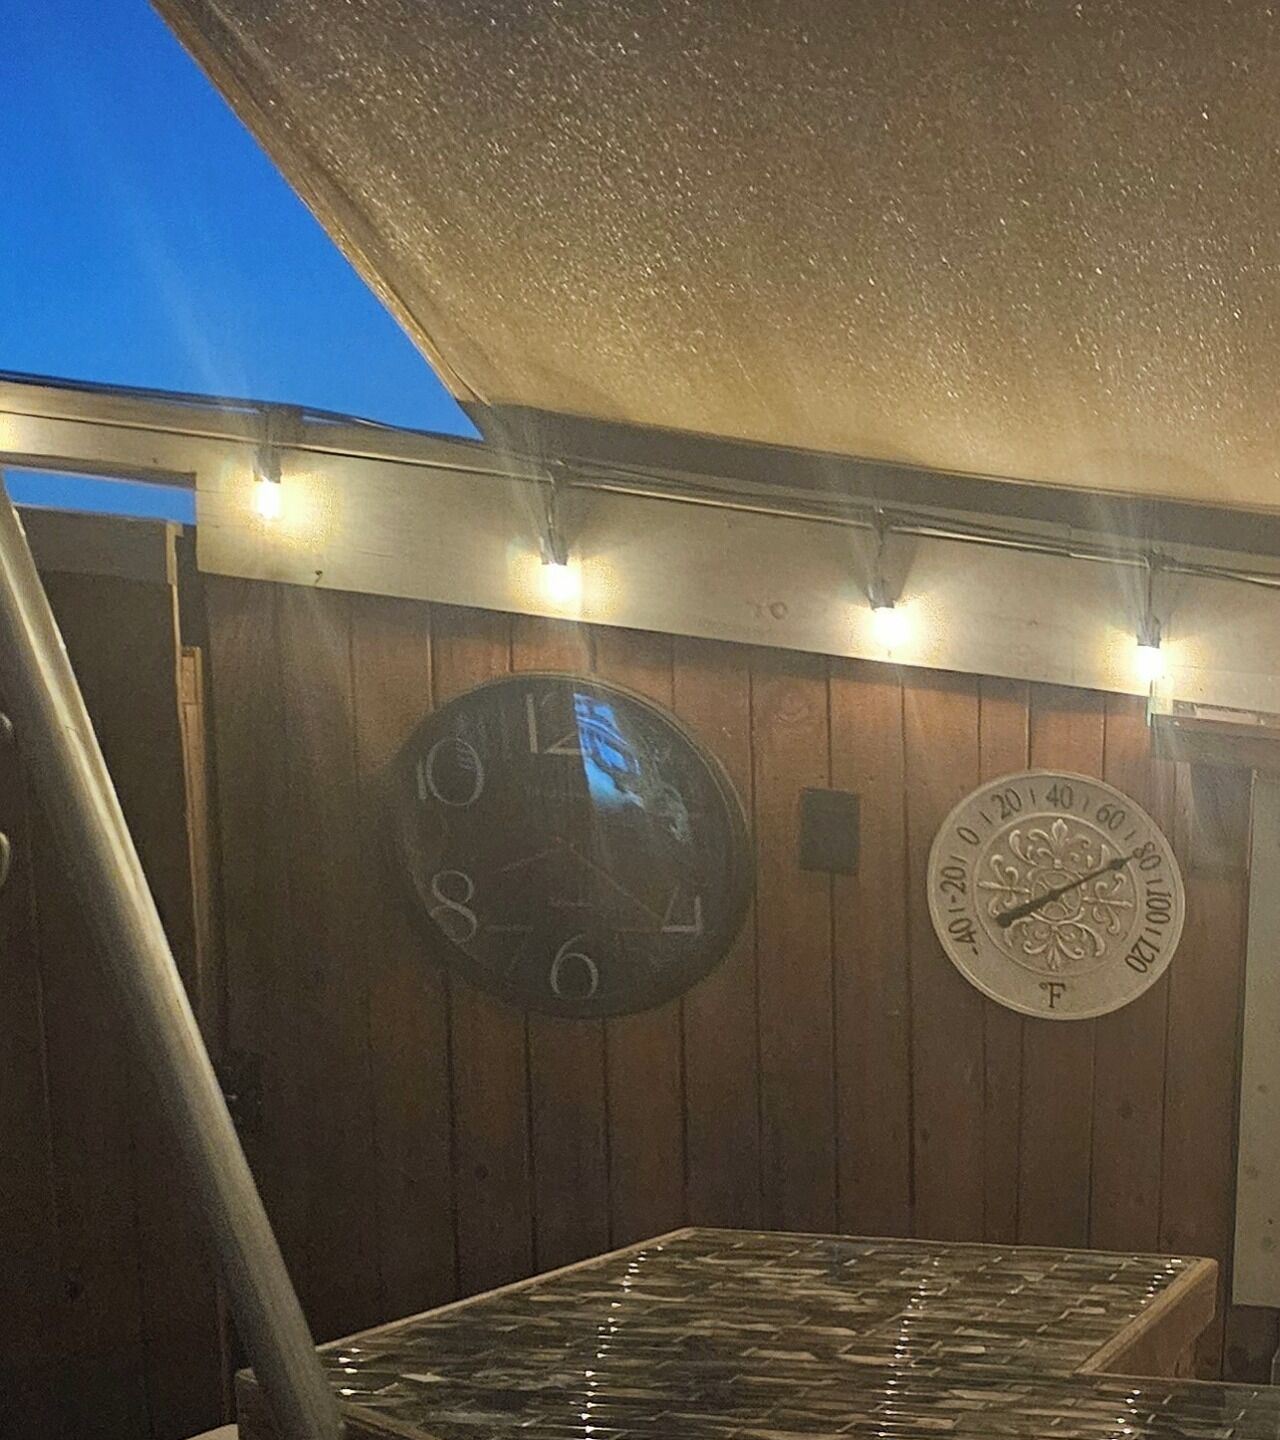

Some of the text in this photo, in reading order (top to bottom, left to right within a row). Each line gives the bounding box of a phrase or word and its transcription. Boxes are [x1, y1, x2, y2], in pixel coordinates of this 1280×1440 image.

[416, 737, 485, 807] 10
[991, 788, 1023, 821] 20
[1045, 784, 1074, 810] 40
[1095, 803, 1127, 831] 60
[956, 827, 981, 846] 0
[1132, 841, 1162, 872] 80
[430, 869, 478, 944] 8
[1145, 889, 1173, 924] 100
[550, 932, 600, 999] 6
[1124, 937, 1162, 974] 120
